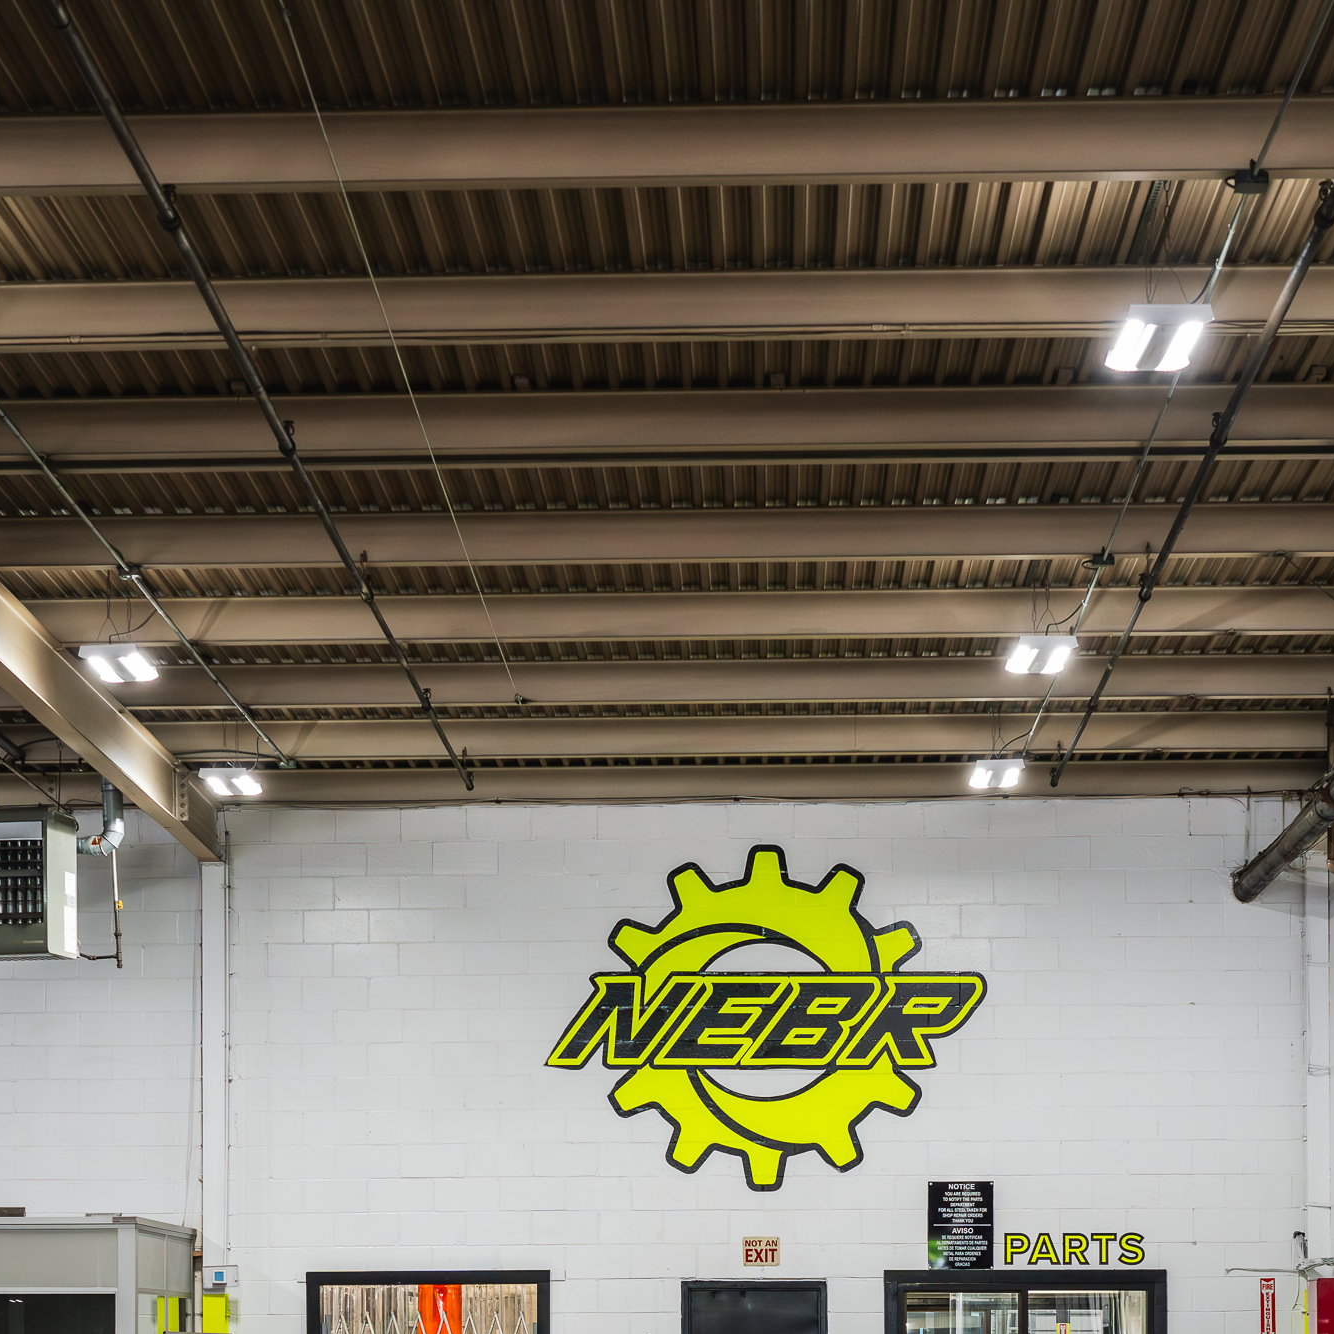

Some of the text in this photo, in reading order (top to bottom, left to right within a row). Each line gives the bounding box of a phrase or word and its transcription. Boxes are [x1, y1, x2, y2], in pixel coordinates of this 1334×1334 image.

[544, 971, 987, 1070] NEBR
[745, 1249, 777, 1263] EXIT
[1004, 1232, 1145, 1265] PARTS
